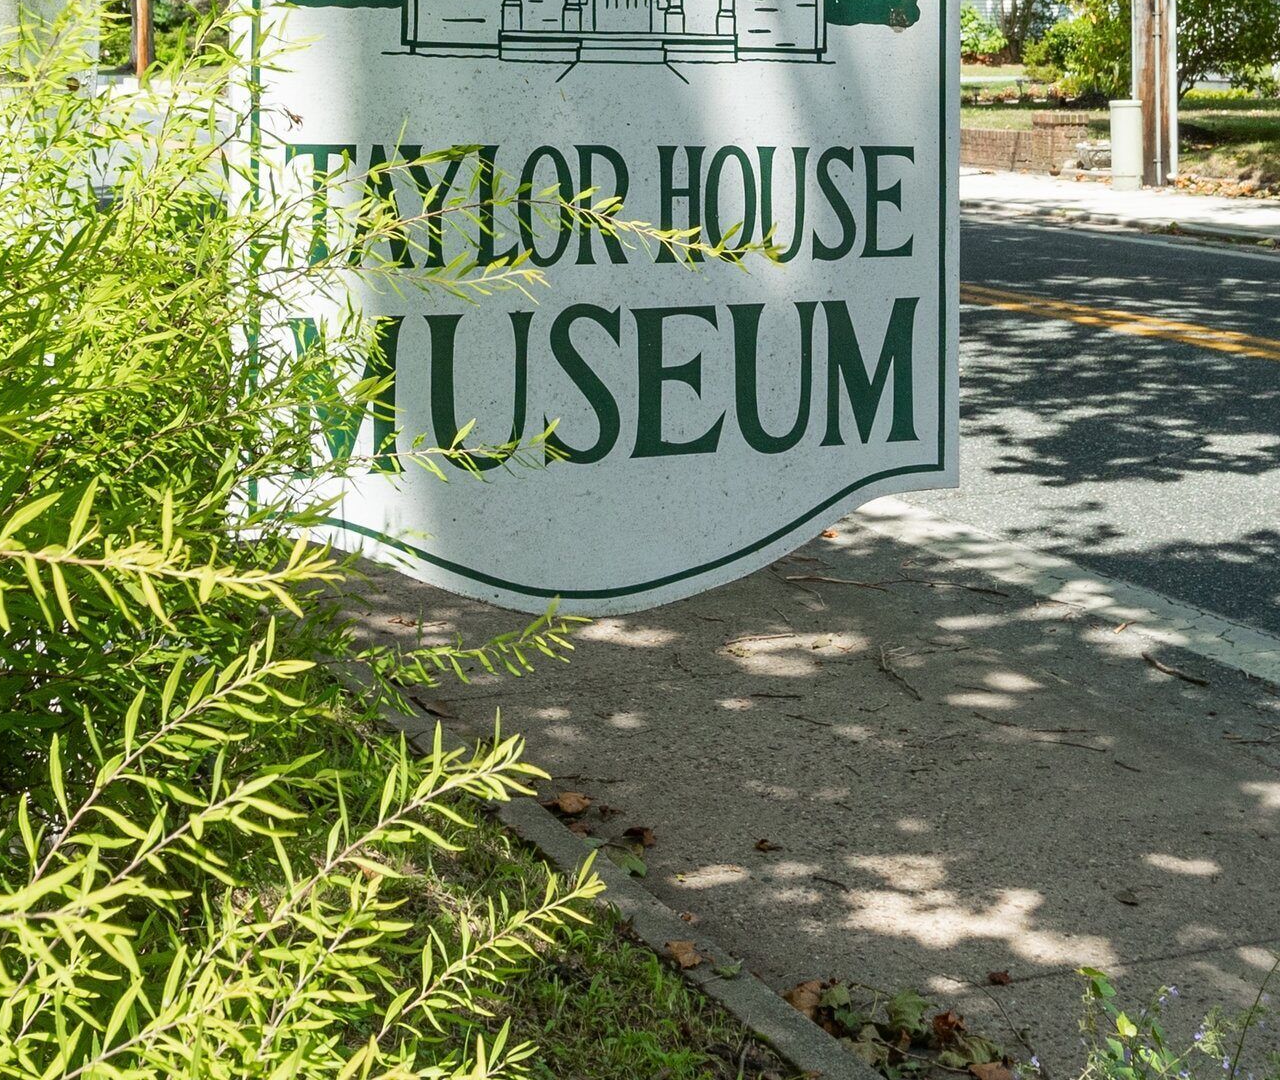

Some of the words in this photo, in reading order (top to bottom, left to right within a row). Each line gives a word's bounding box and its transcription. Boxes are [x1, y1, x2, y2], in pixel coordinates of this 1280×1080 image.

[286, 143, 629, 268] TAYLOR
[655, 144, 915, 264] HOUSE
[287, 297, 920, 479] MUSEUM
